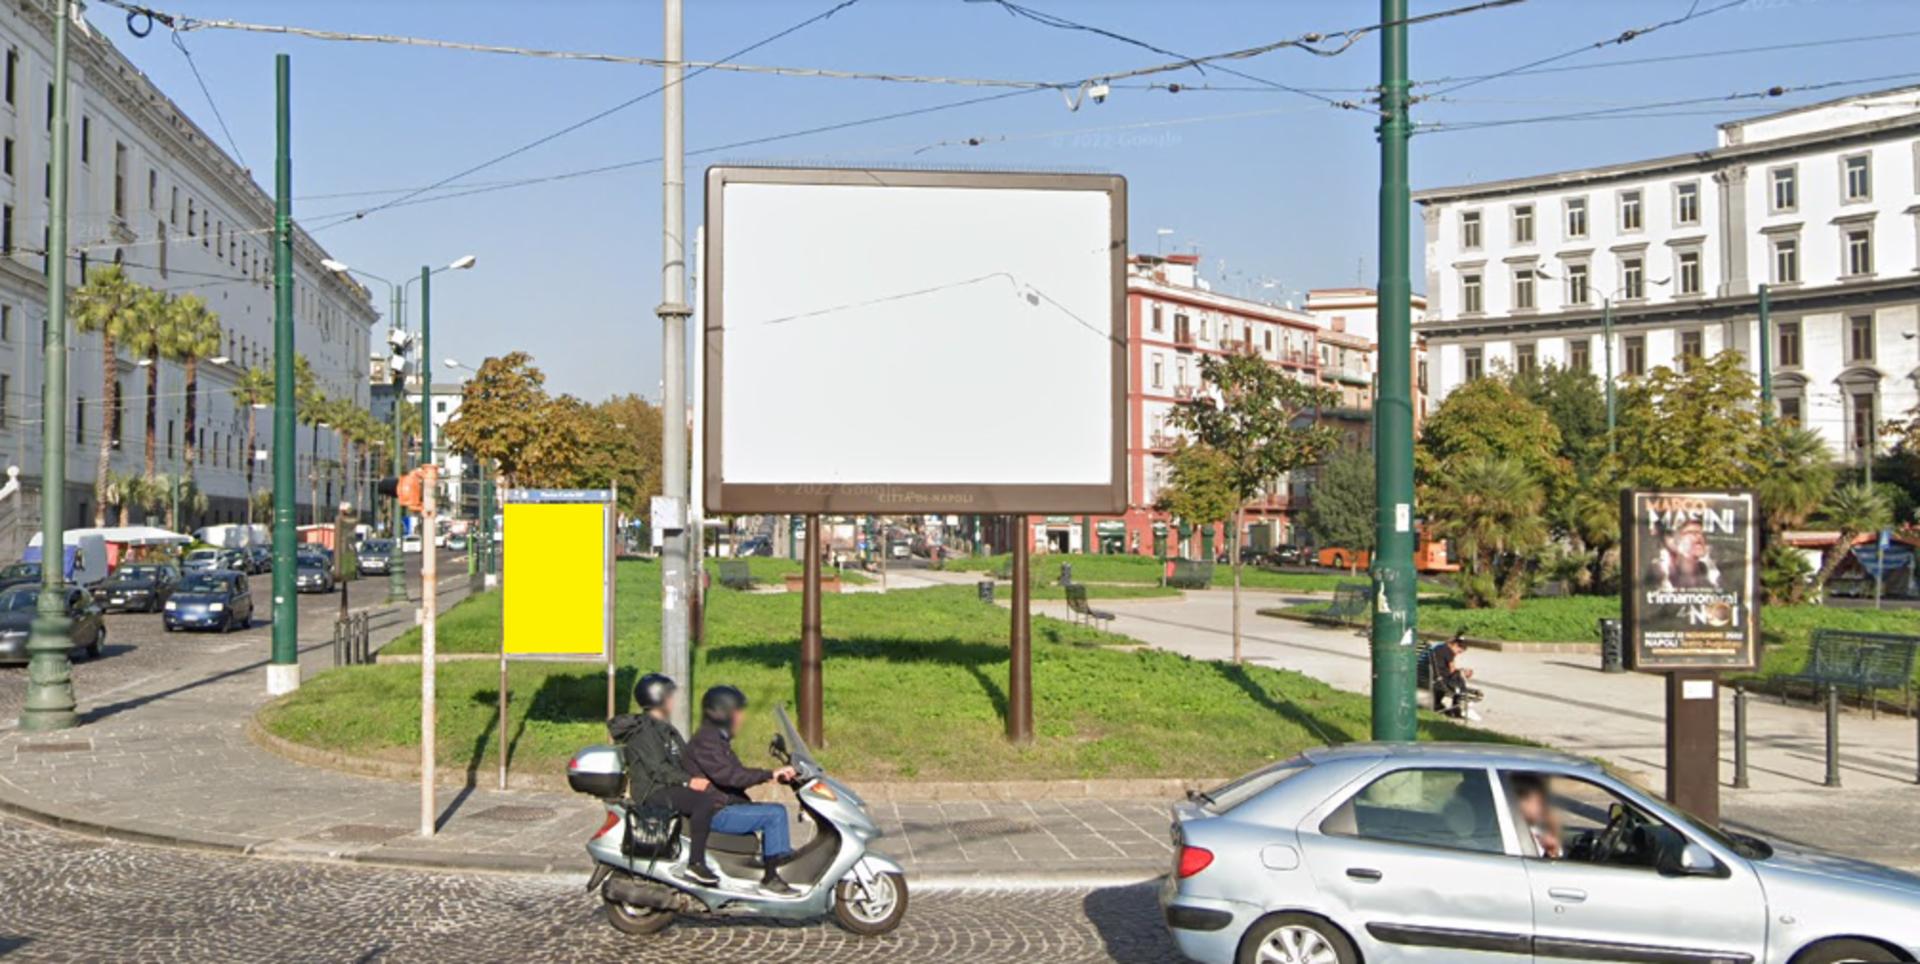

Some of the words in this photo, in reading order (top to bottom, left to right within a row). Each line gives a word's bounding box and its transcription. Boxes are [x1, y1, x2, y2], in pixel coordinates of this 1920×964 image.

[932, 494, 974, 503] NAPOLI
[1648, 508, 1735, 534] MASINI
[1690, 604, 1739, 626] NOI
[1644, 639, 1679, 648] NAPOLI
